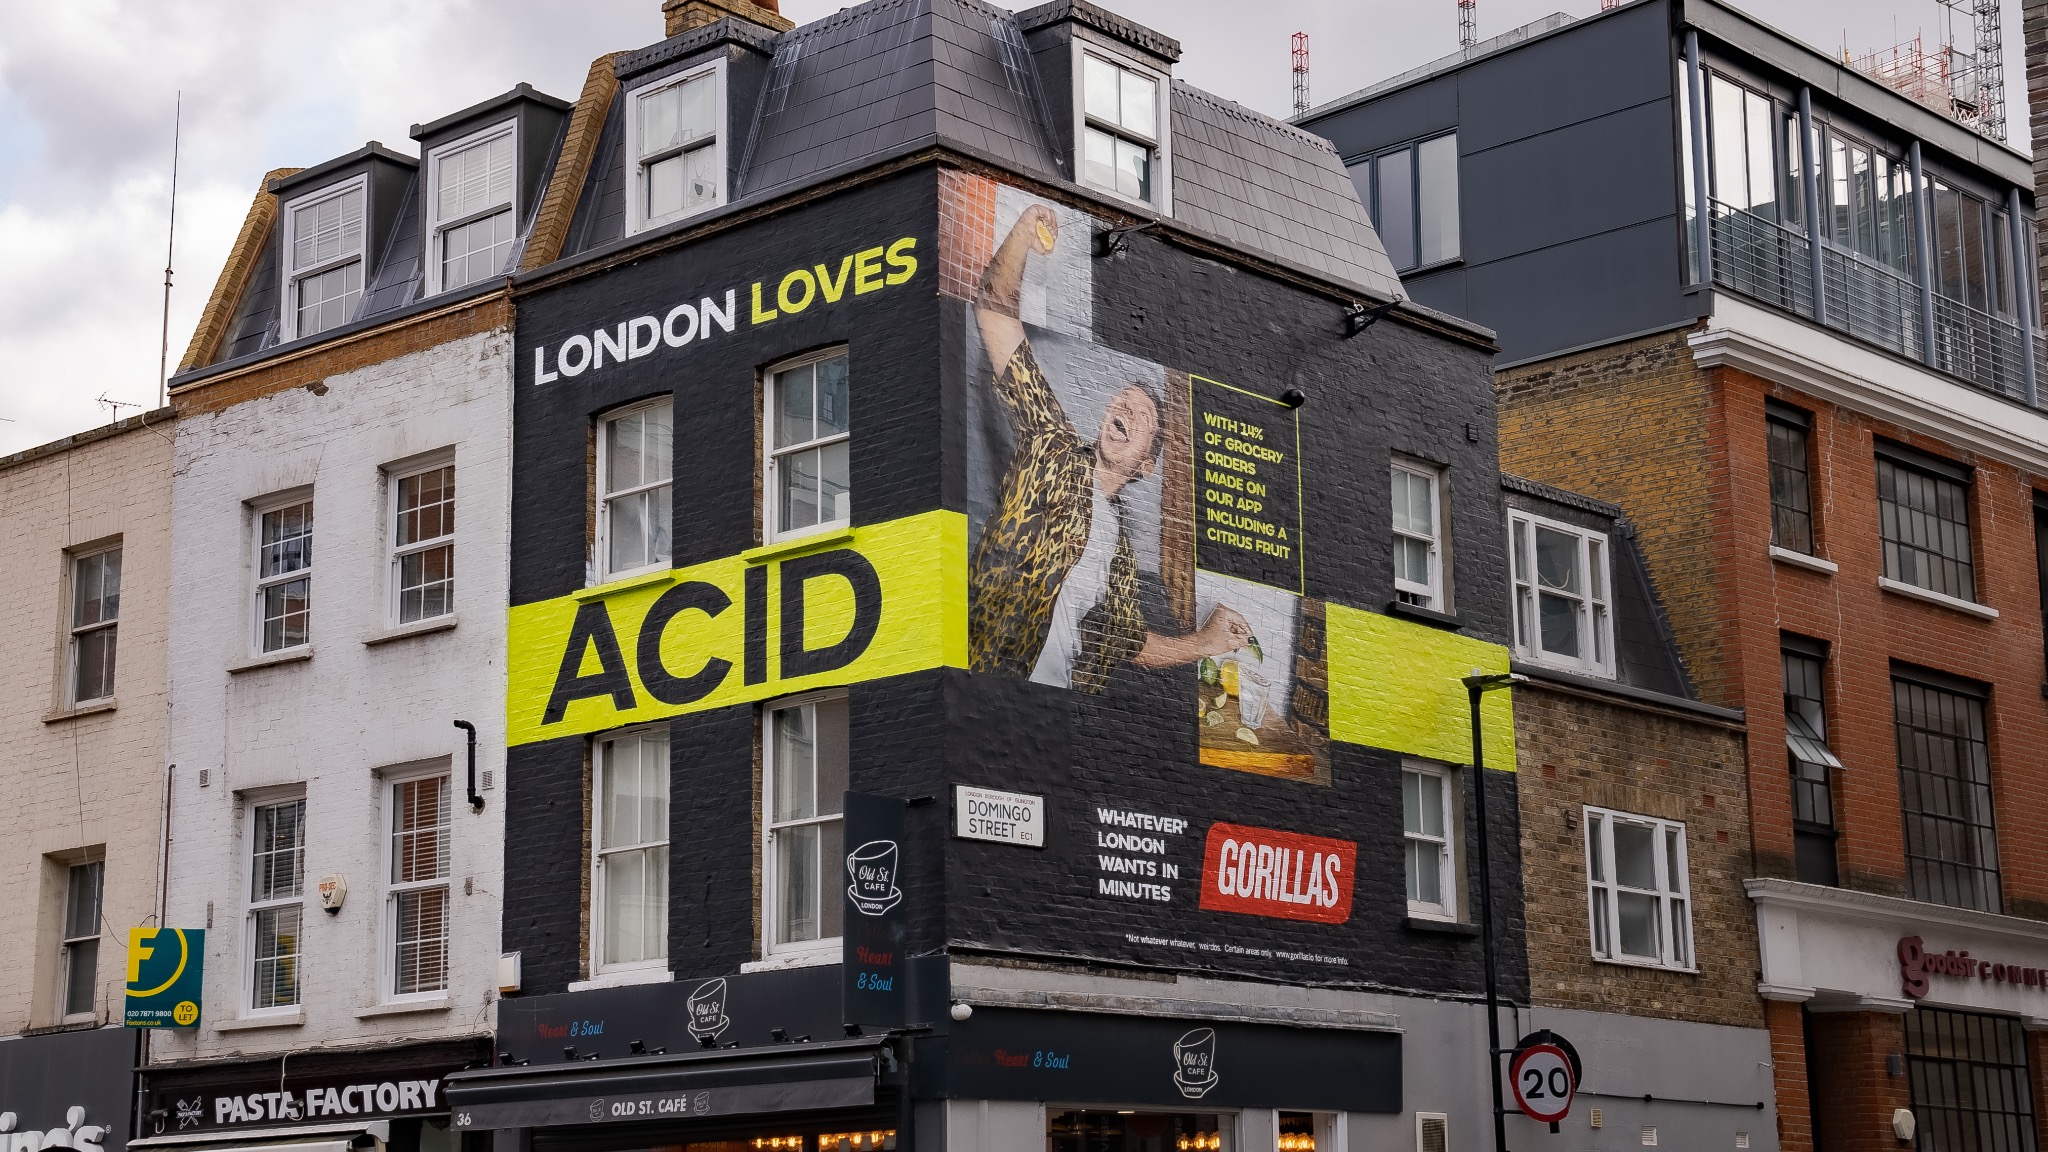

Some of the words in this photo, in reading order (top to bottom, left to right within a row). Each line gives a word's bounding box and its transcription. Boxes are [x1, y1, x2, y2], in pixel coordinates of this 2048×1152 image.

[534, 289, 736, 386] LONDON
[751, 237, 918, 326] LOVES
[1203, 412, 1238, 434] WITH
[1240, 422, 1264, 441] 14%
[1204, 431, 1222, 446] OF
[1225, 437, 1284, 464] GROCERY
[1205, 450, 1256, 476] ORDERS
[1205, 469, 1243, 492] MADE
[1246, 481, 1266, 497] ON
[1206, 488, 1233, 508] OUR
[1236, 497, 1262, 514] APP
[1206, 507, 1275, 537] INCLUDING
[1278, 527, 1287, 541] A
[1206, 527, 1253, 551] CITRUS
[1255, 539, 1290, 560] FRUIT
[541, 548, 882, 726] ACID
[985, 794, 1005, 802] BOROUGH
[968, 799, 1031, 822] DOMINGO
[968, 818, 1016, 838] STREET
[1020, 832, 1033, 841] EC1
[1098, 831, 1165, 855] LONDON
[858, 865, 874, 881] Old
[876, 867, 889, 883] St.
[1098, 854, 1157, 877] WANTS
[1162, 862, 1179, 879] IN
[1218, 838, 1340, 909] GORILLAS
[864, 882, 885, 892] CAFE
[1099, 878, 1171, 902] MINUTES
[861, 902, 883, 910] LONDON
[857, 946, 893, 965] Heart
[1140, 935, 1168, 946] whatever
[1225, 945, 1244, 954] Certain
[1245, 948, 1259, 956] areas
[1324, 956, 1336, 964] more
[1897, 936, 1978, 998] goodsir
[857, 972, 867, 989] &
[868, 973, 893, 991] Soul
[696, 1004, 709, 1016] Old
[700, 1015, 717, 1023] CAFE
[538, 1023, 567, 1039] Heart
[570, 1021, 579, 1037] &
[581, 1020, 604, 1036] Soul
[1033, 1051, 1043, 1067] &
[1045, 1052, 1070, 1069] Soul
[1183, 1051, 1198, 1066] Old
[1187, 1067, 1205, 1076] CAFE
[1524, 1067, 1568, 1099] 20
[215, 1091, 299, 1124] PASTA
[307, 1079, 439, 1117] FACTORY
[611, 1101, 636, 1116] OLD
[638, 1100, 655, 1115] ST.
[658, 1094, 687, 1113] CAFÉ
[457, 1112, 472, 1126] 36
